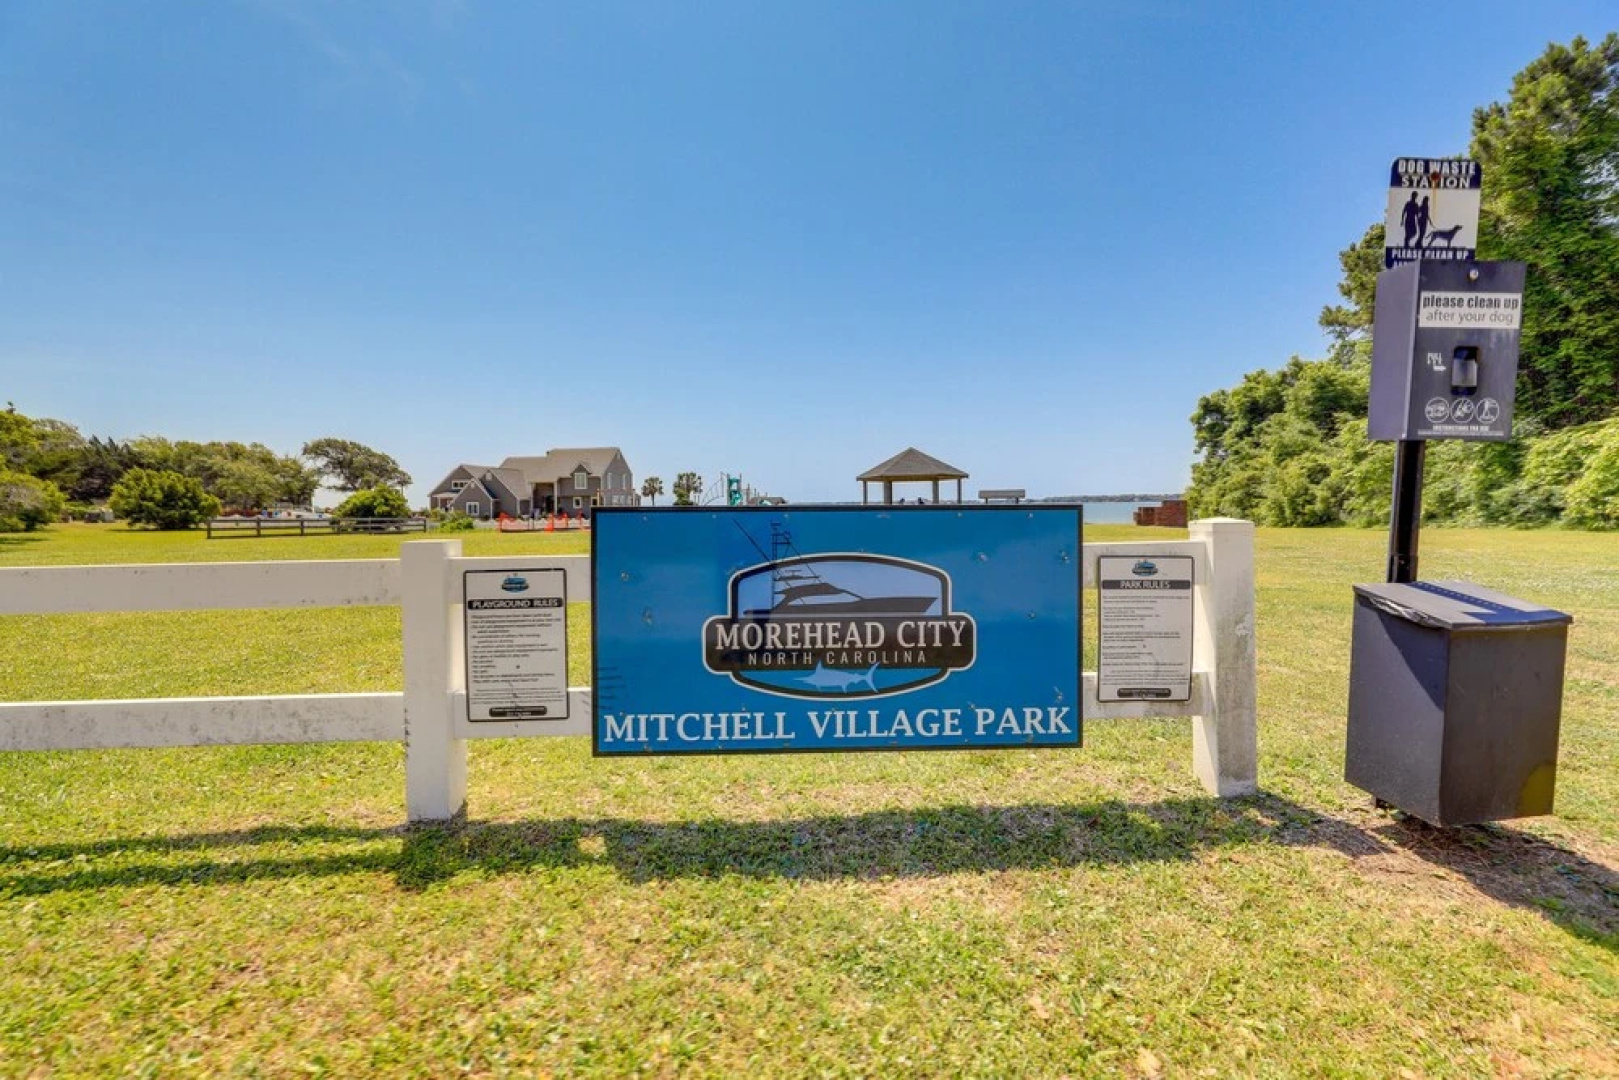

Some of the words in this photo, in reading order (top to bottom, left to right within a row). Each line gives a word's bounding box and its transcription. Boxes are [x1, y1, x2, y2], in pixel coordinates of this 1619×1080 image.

[1398, 160, 1425, 174] DOG
[1429, 161, 1476, 175] WASTE
[1391, 249, 1422, 259] PLEASE
[1424, 250, 1453, 260] CLEAN
[1456, 250, 1469, 260] UP
[1422, 294, 1465, 308] please
[1466, 295, 1501, 309] clean
[1503, 299, 1519, 310] up
[1425, 308, 1455, 322] after
[1458, 312, 1486, 324] your
[1489, 311, 1514, 326] dog
[1119, 580, 1142, 589] PARK
[1143, 580, 1171, 589] RULES
[472, 600, 531, 609] PLAYGROUND
[533, 598, 558, 607] RULES
[715, 621, 886, 651] MOREHEAD
[896, 620, 968, 648] CITY
[748, 652, 813, 666] NORTH
[825, 650, 927, 666] CAROLINA
[604, 711, 796, 743] MITCHELL
[807, 708, 963, 740] VILLAGE
[973, 706, 1072, 736] PARK
